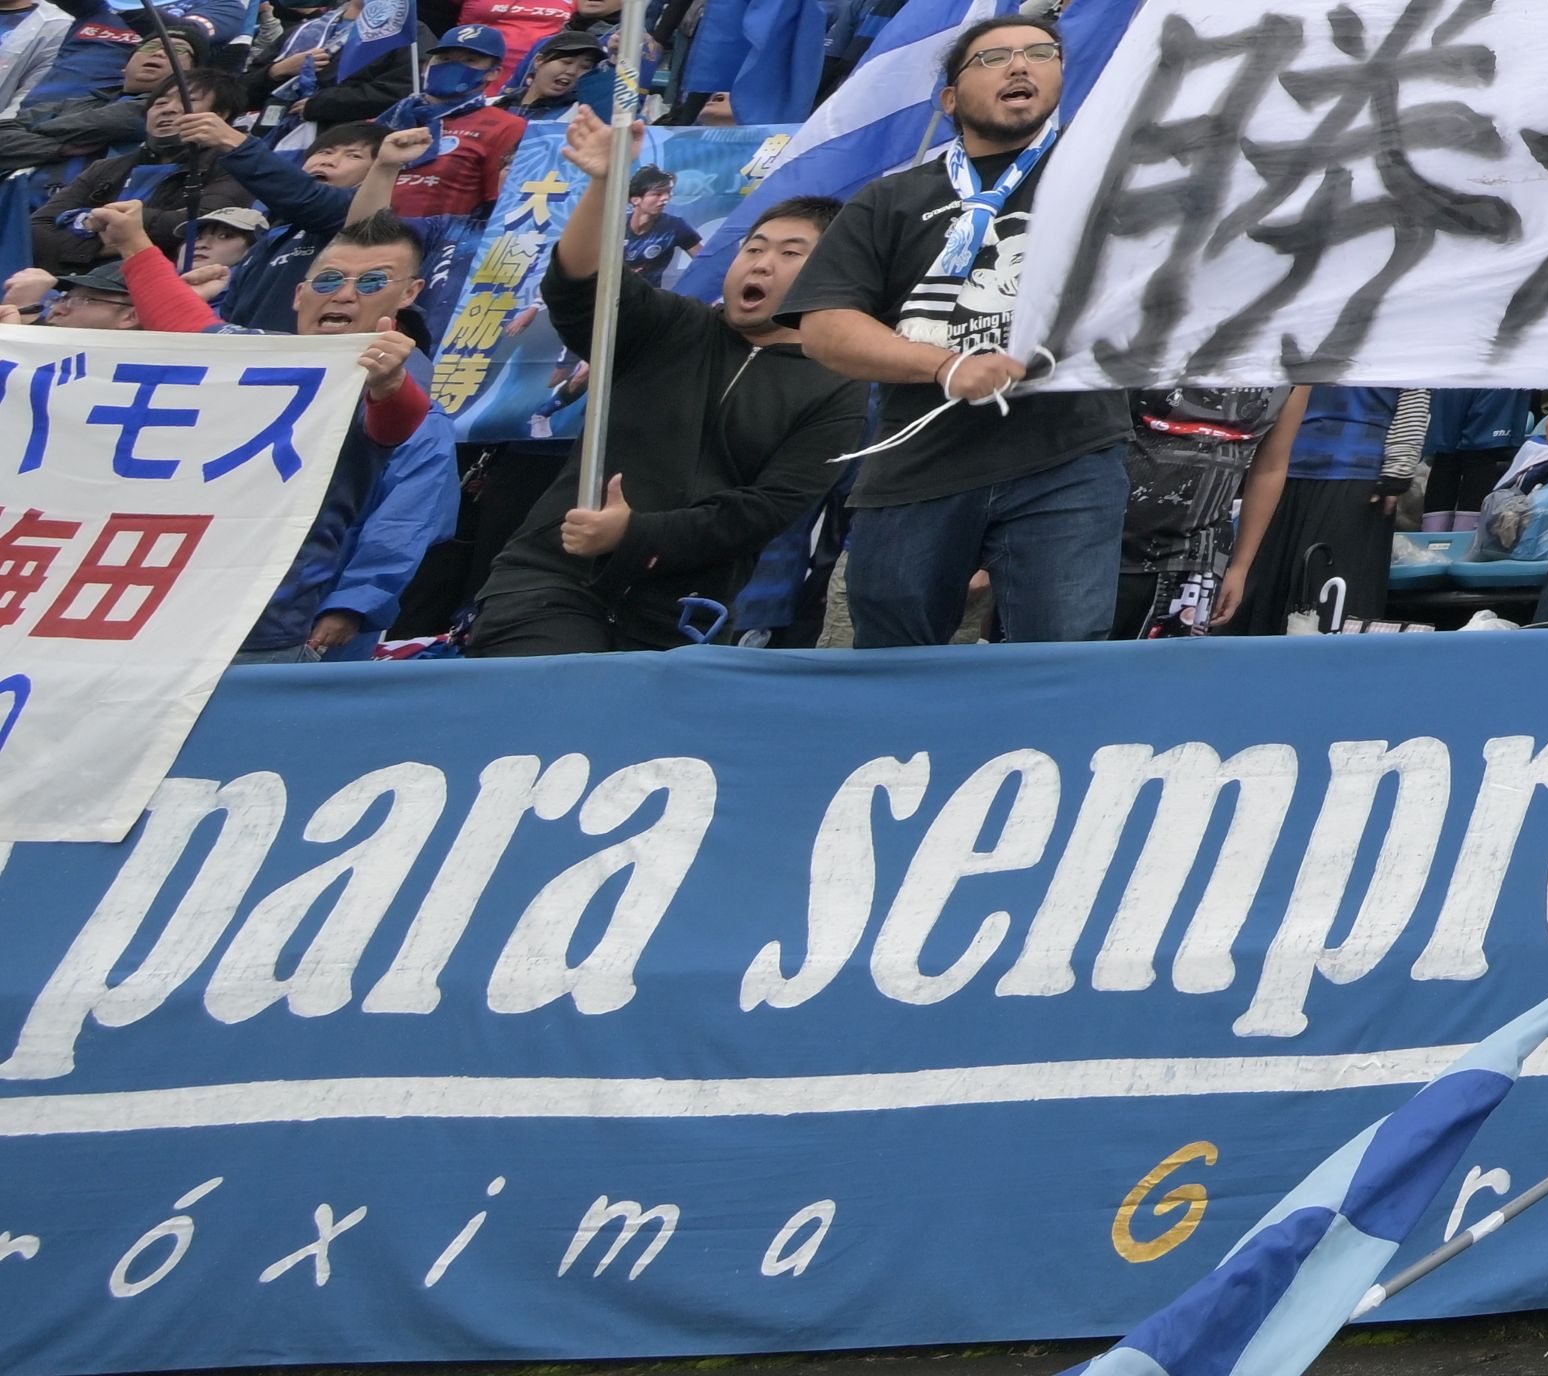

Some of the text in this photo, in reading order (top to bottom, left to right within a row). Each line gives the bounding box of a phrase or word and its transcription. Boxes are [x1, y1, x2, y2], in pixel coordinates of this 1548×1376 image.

[969, 314, 1000, 334] king
[0, 752, 718, 1081] para
[0, 1175, 837, 1299] óxima
